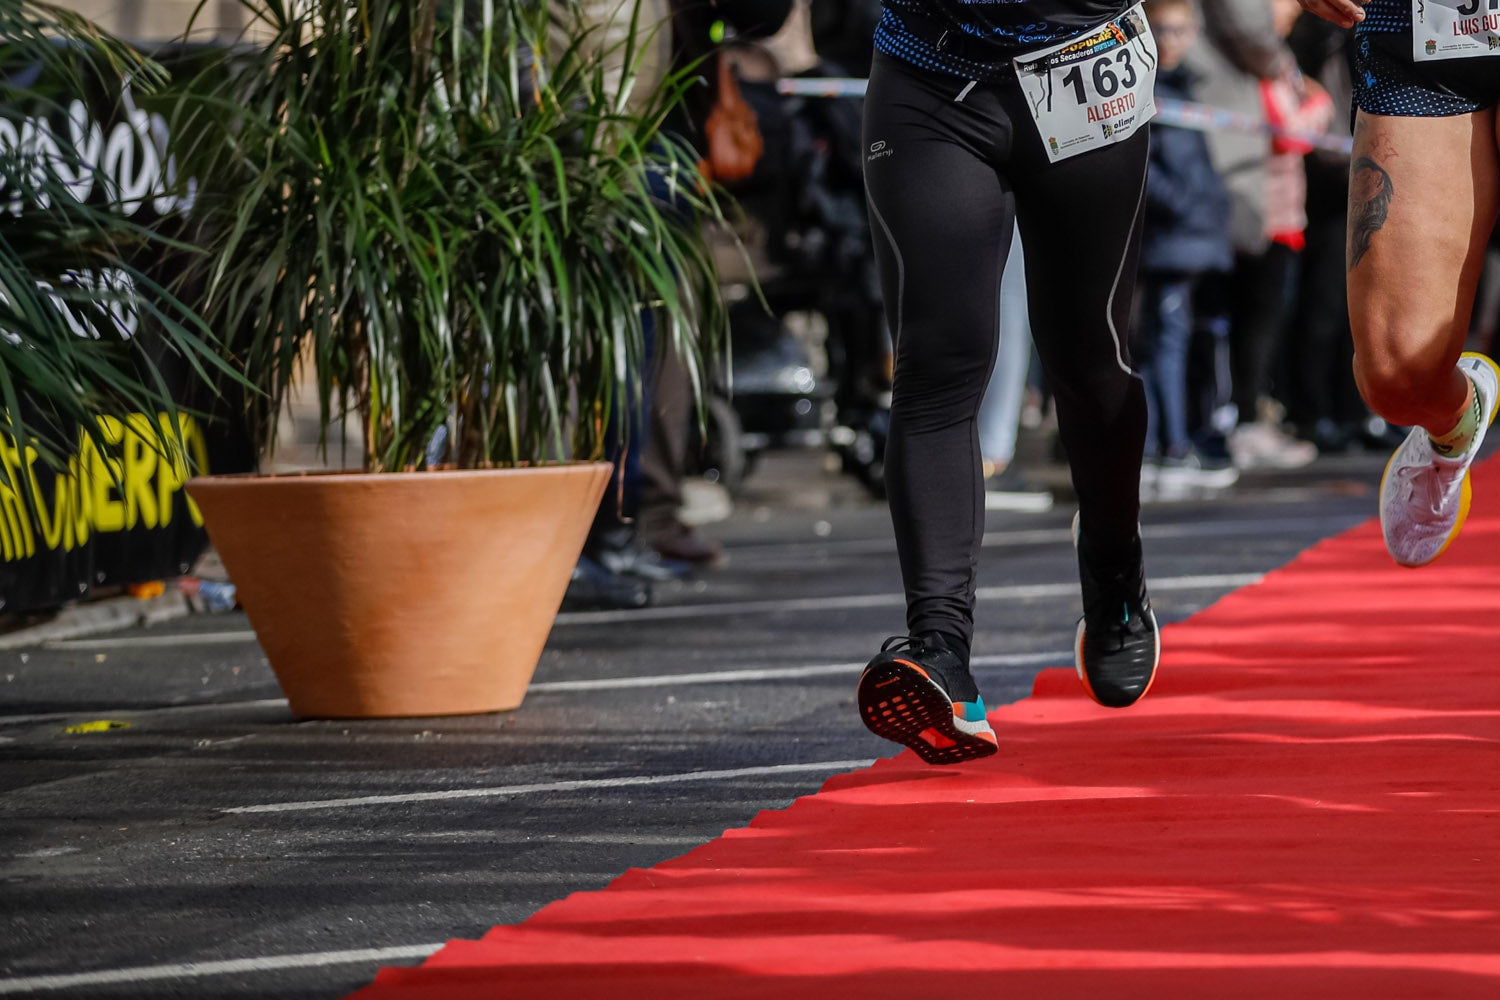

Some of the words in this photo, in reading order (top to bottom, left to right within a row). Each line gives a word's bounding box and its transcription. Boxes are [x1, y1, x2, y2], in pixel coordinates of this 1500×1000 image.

[1452, 17, 1480, 37] LUIS
[1060, 48, 1094, 62] Secaderos
[1062, 47, 1138, 106] 163
[1086, 92, 1136, 124] ALBERTO
